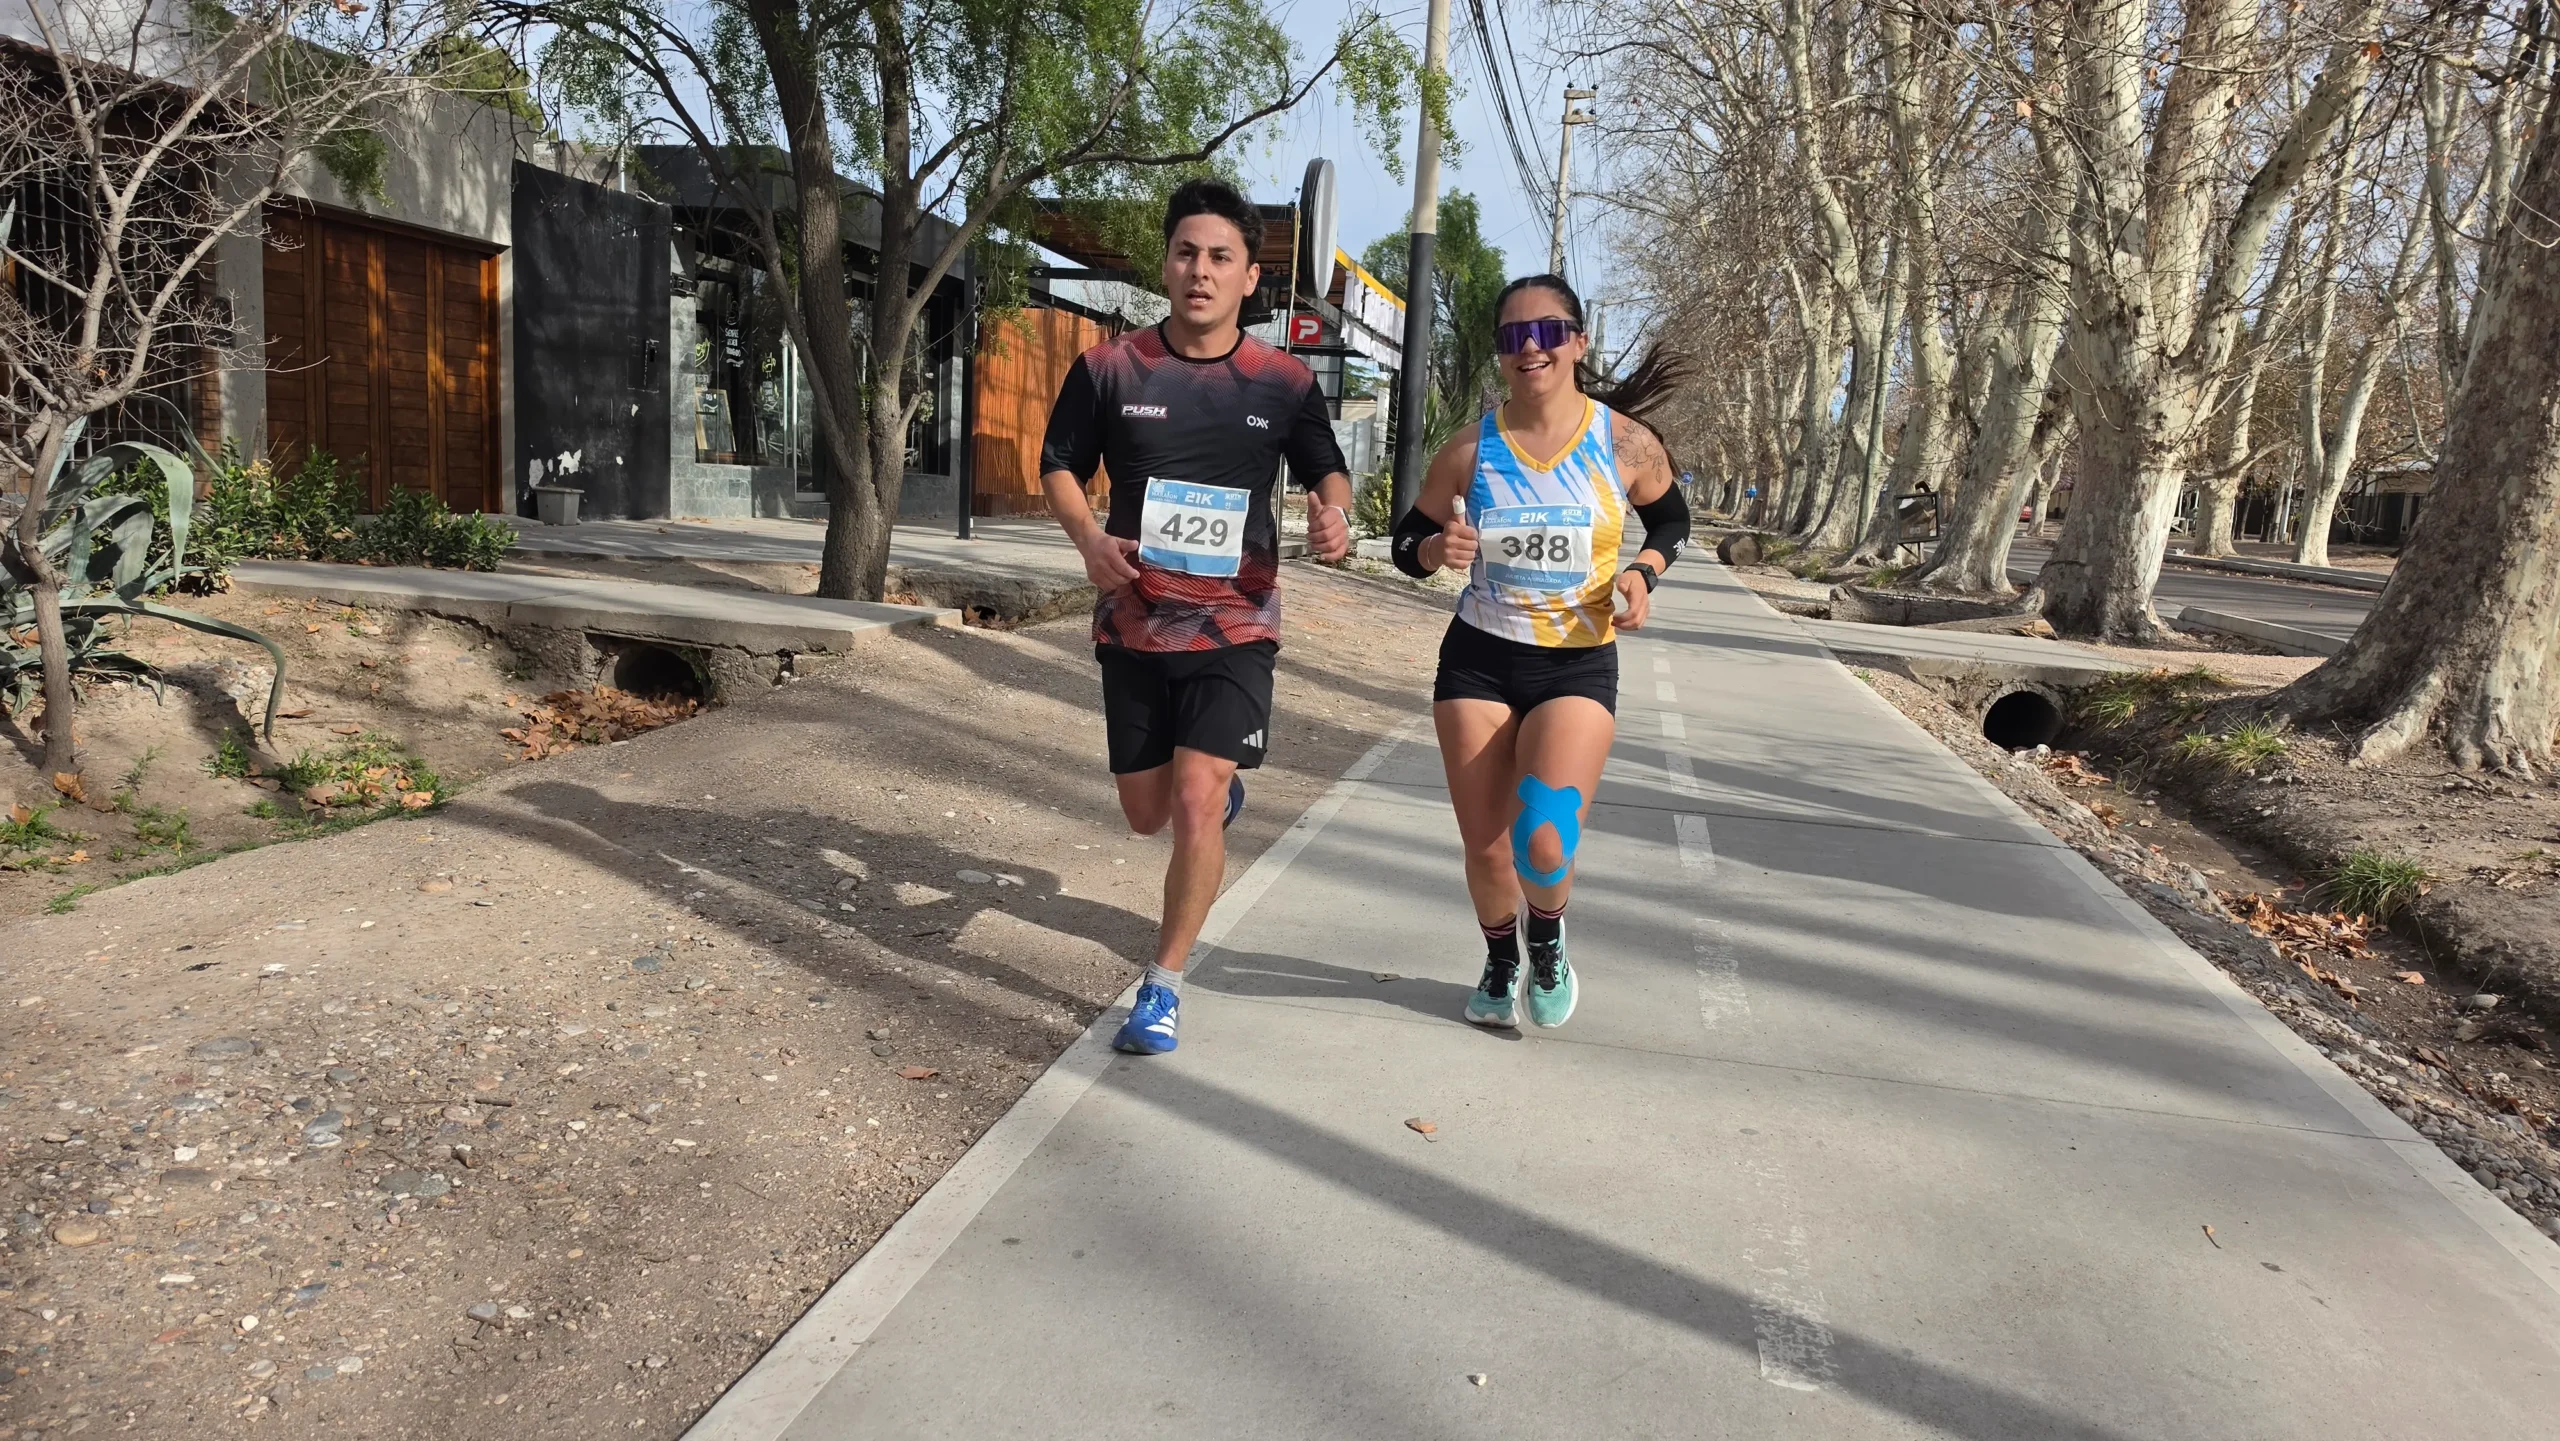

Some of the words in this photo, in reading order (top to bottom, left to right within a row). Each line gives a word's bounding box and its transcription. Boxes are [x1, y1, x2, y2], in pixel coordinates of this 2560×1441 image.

[1298, 320, 1319, 339] P
[1122, 405, 1166, 415] PUSH
[1184, 491, 1214, 506] 21K
[1519, 511, 1550, 524] 21K
[1160, 513, 1229, 547] 429
[1500, 533, 1570, 563] 388
